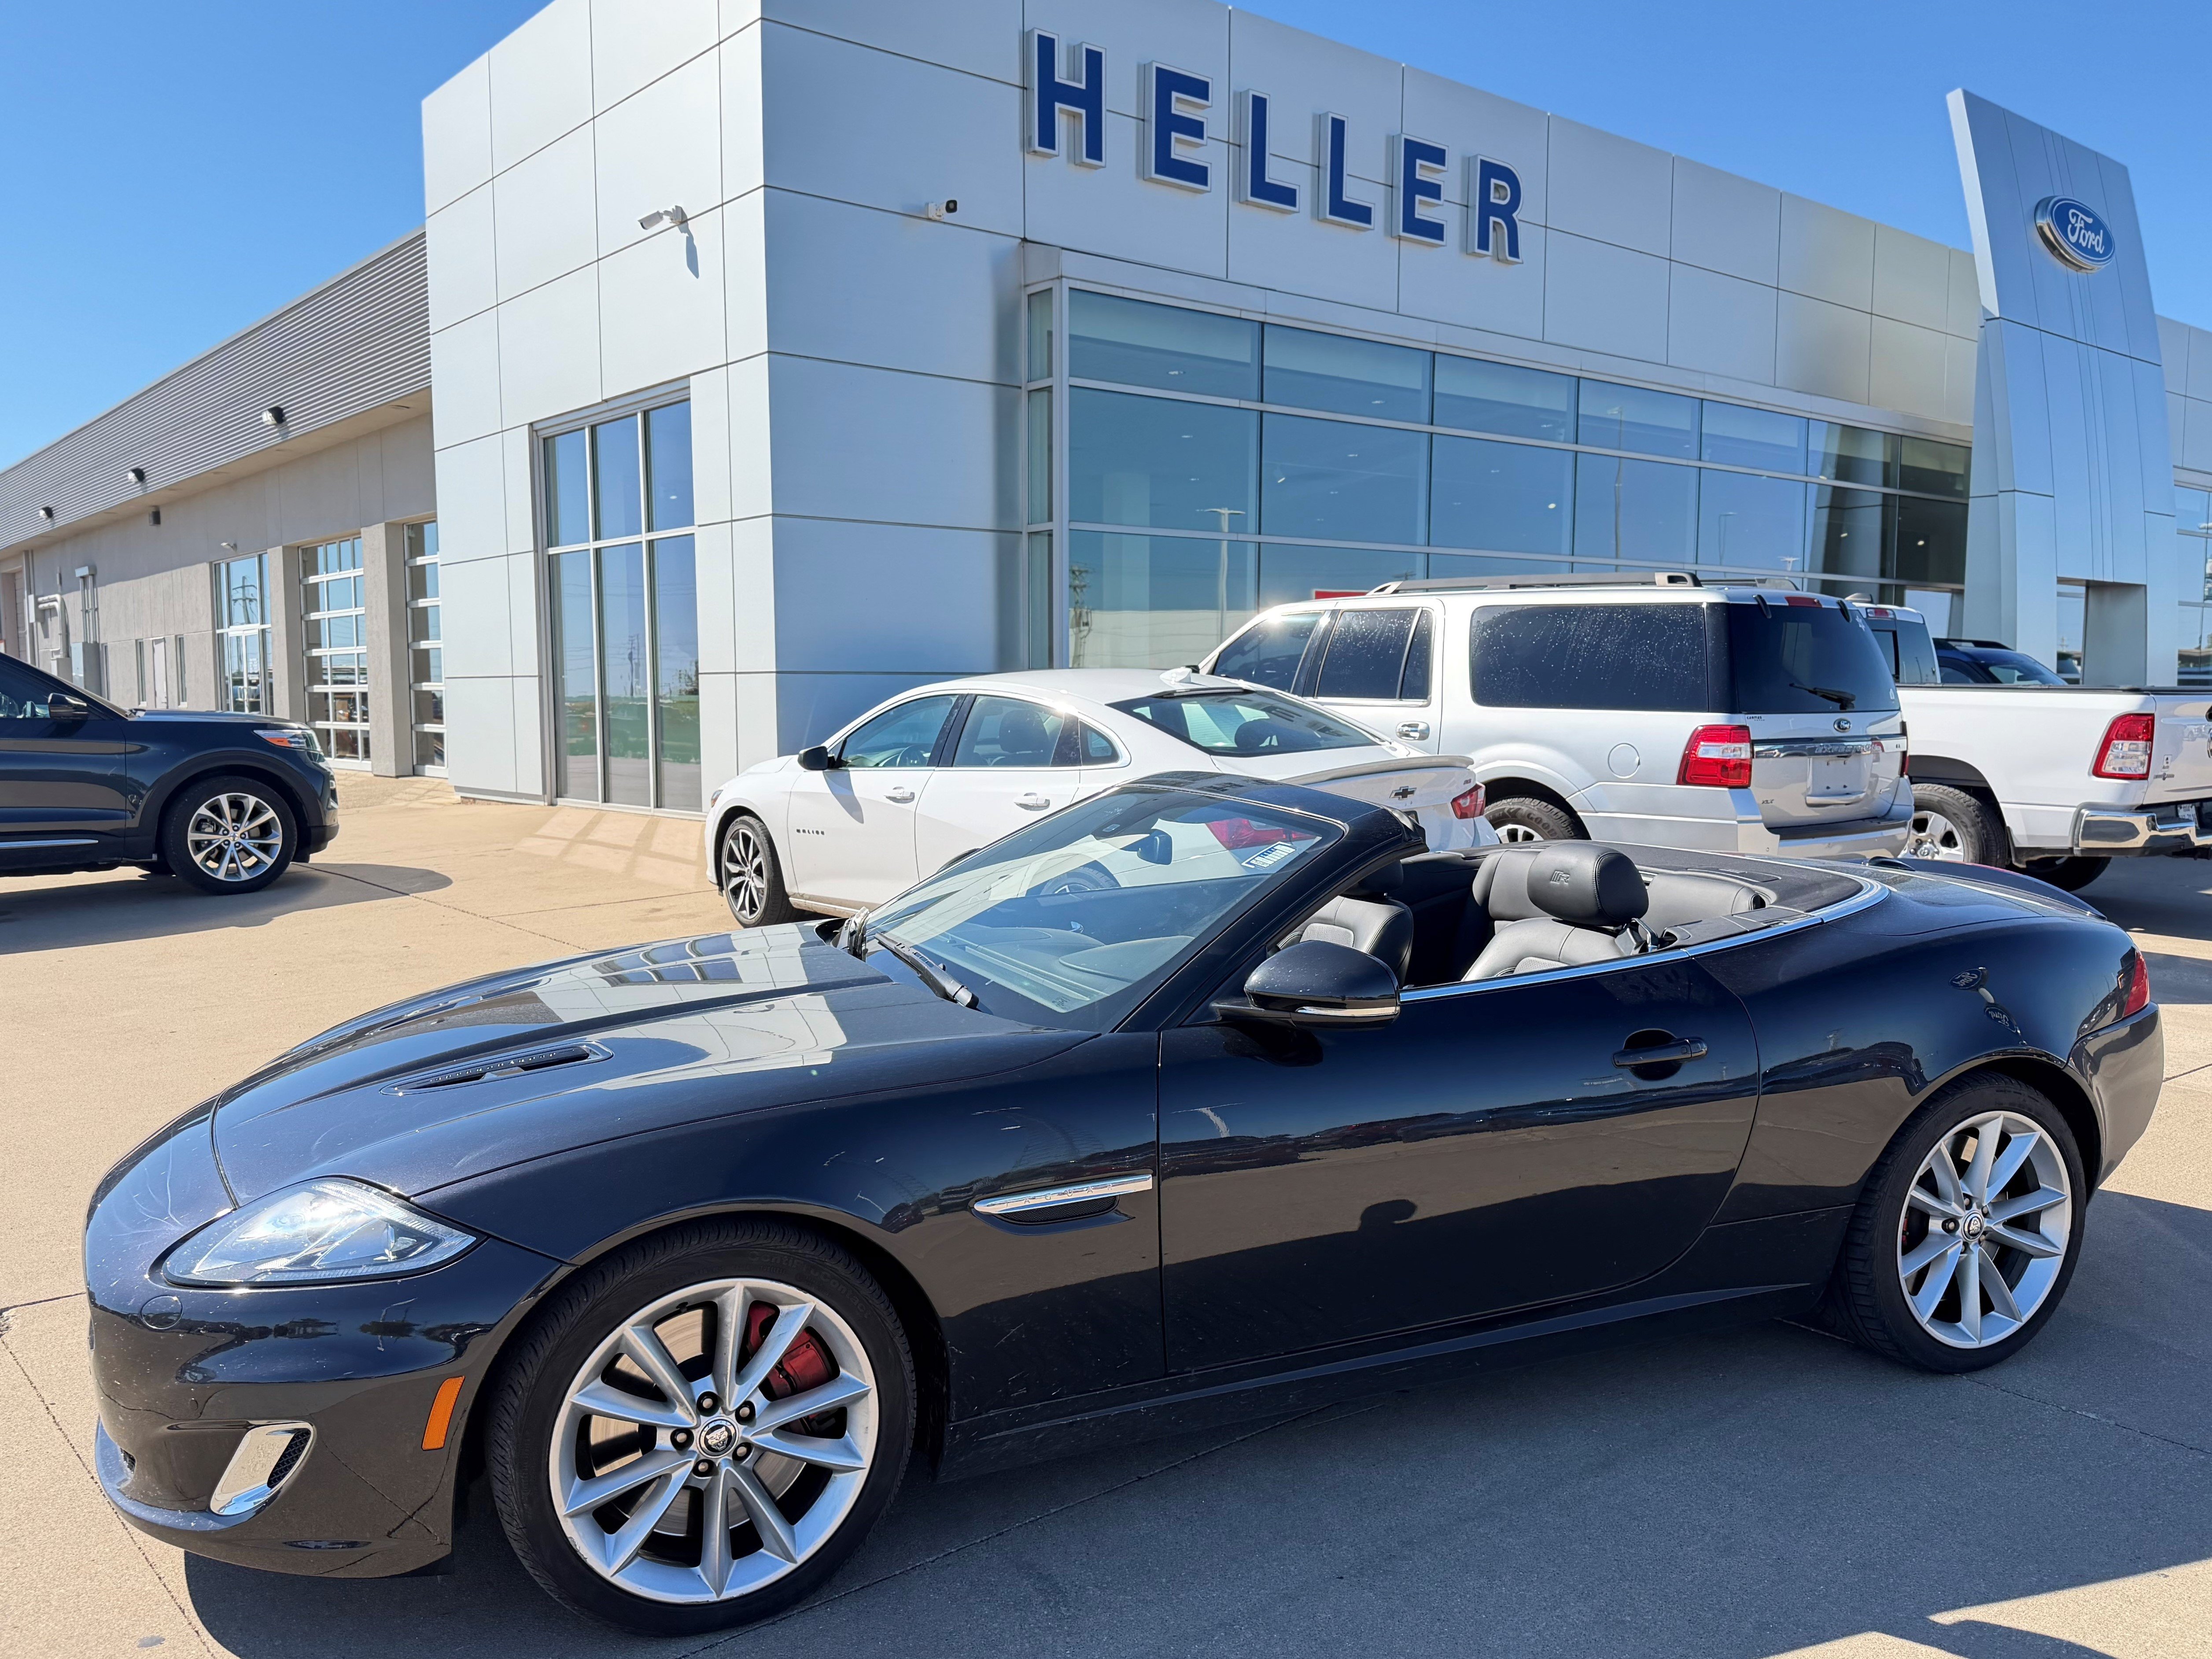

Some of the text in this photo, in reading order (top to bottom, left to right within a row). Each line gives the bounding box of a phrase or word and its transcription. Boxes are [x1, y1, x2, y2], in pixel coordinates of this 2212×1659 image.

[1027, 28, 1523, 264] HELLER
[2068, 209, 2104, 254] Ford
[1527, 812, 1557, 837] GOOD
